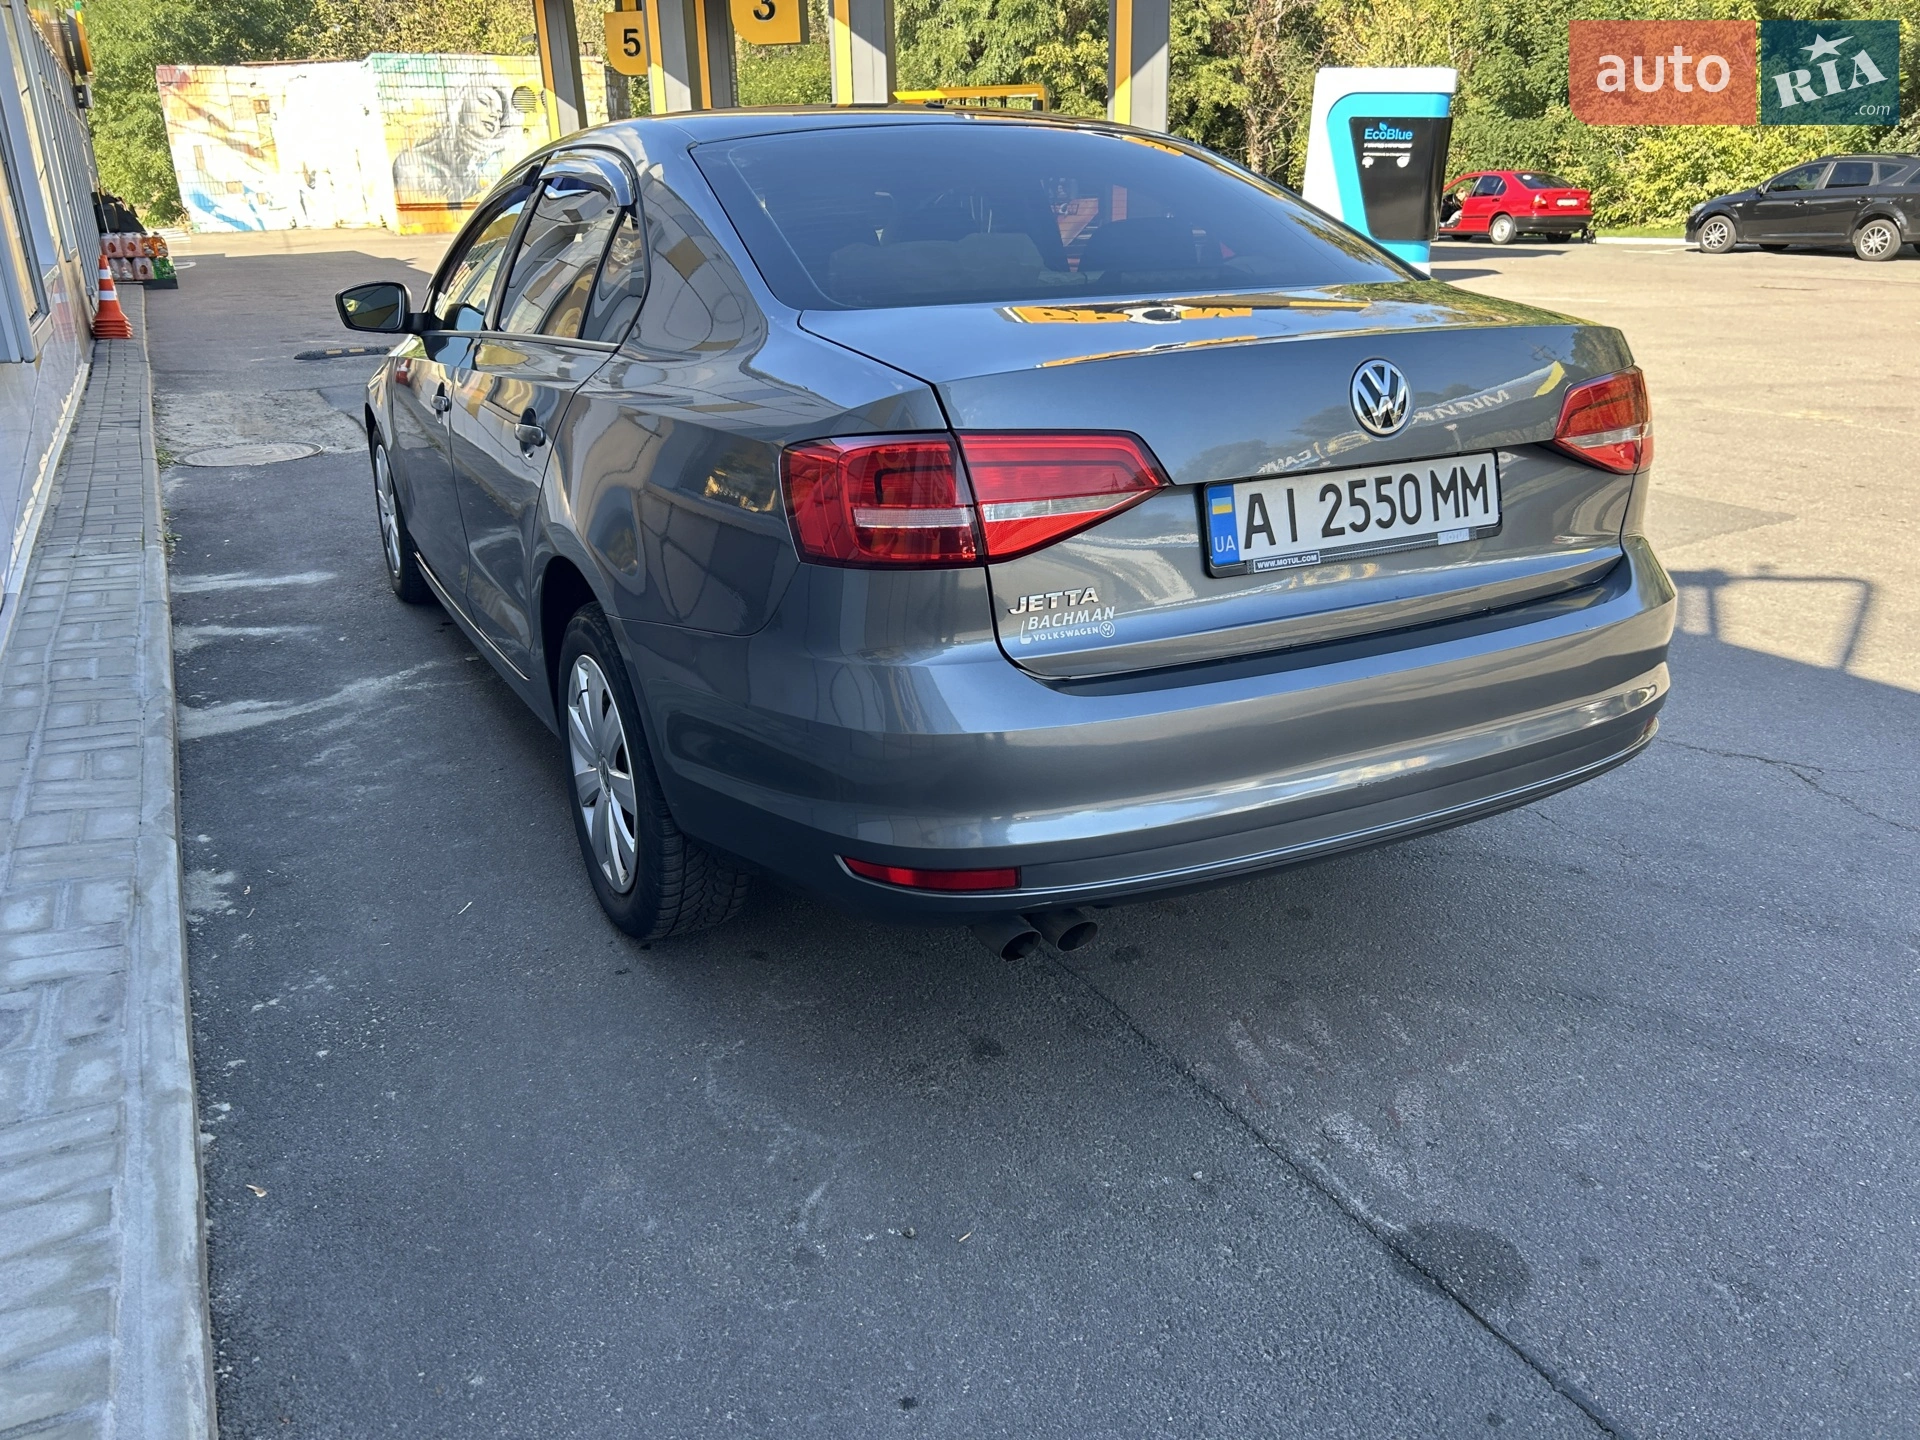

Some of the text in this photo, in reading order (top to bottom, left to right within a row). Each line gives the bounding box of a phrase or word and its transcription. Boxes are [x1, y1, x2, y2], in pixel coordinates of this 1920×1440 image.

[623, 28, 641, 57] 5
[1364, 128, 1413, 140] EcoBlue
[1244, 463, 1489, 549] AI 2550 MM
[1215, 535, 1236, 553] UA
[1257, 554, 1317, 569] WWW.MOTUL.COM
[1008, 586, 1099, 615] JETTA
[1028, 606, 1115, 630] BACHMAN
[1033, 626, 1099, 641] VOLKSWAGEN
